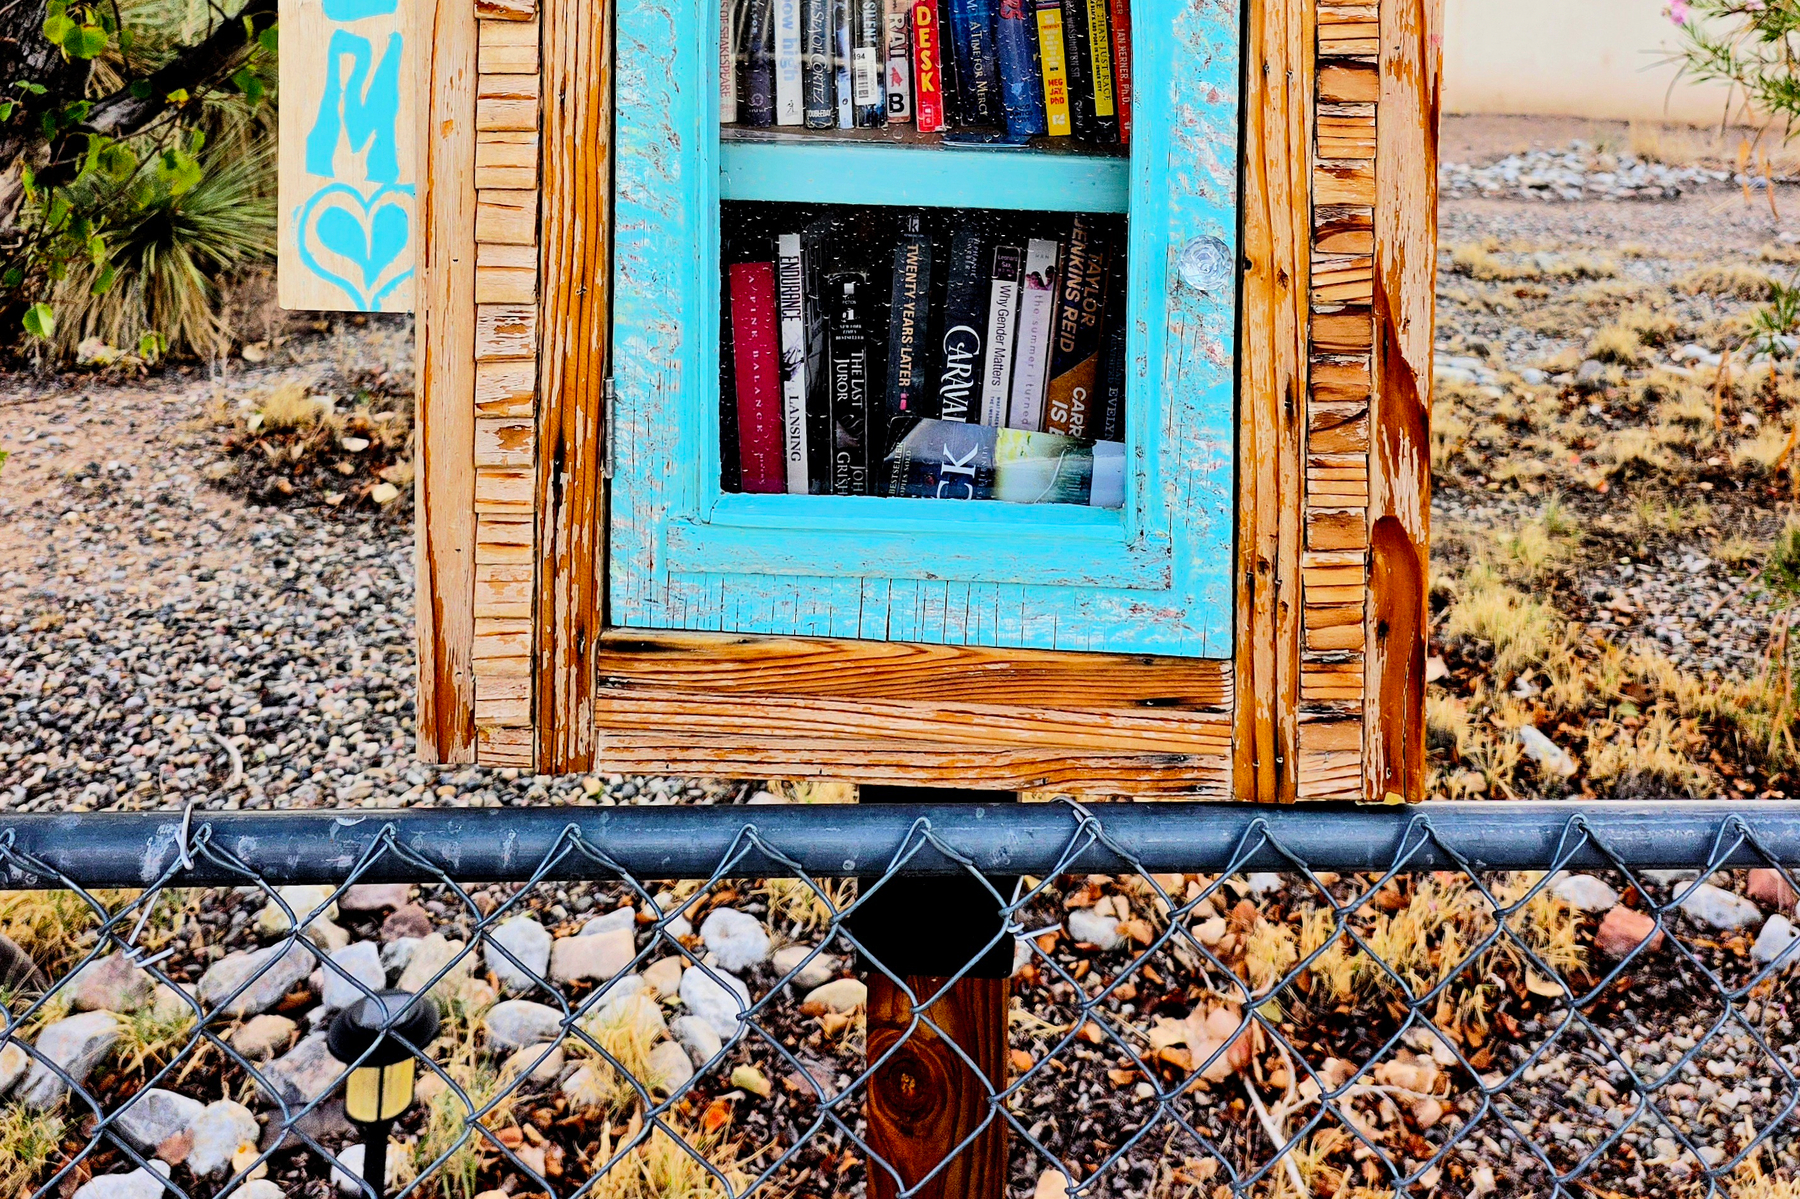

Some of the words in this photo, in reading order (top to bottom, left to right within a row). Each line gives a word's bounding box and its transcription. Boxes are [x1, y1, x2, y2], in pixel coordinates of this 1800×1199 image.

[863, 1, 879, 43] SILENT
[889, 13, 908, 62] RAI
[1096, 12, 1108, 43] THAN
[1117, 28, 1126, 45] IAN
[720, 26, 731, 97] SHAKESPEARE
[780, 38, 798, 82] high
[916, 5, 935, 93] DESK
[1099, 46, 1110, 72] JUST
[810, 53, 827, 104] CORTEZ
[976, 80, 989, 117] MERCY
[1101, 75, 1112, 102] RACE
[888, 92, 905, 115] B
[904, 244, 920, 300] TWENTY
[1065, 217, 1088, 302] JENKINS
[780, 256, 802, 322] ENDURANCE
[996, 285, 1012, 308] Why
[1032, 295, 1043, 315] the
[1081, 253, 1103, 327] TAYLOR
[901, 302, 916, 346] YEARS
[994, 308, 1010, 346] Gender
[1027, 320, 1041, 369] summer
[1060, 305, 1079, 353] REID
[833, 360, 850, 403] JUROR
[851, 349, 866, 377] THE
[898, 347, 913, 388] LATER
[991, 347, 1008, 387] Matters
[752, 350, 764, 434] BALANCE
[850, 378, 866, 410] LAST
[1020, 383, 1036, 426] turned
[1050, 400, 1069, 424] IS
[788, 395, 802, 463] LANSING
[887, 441, 905, 495] BESTSELLER
